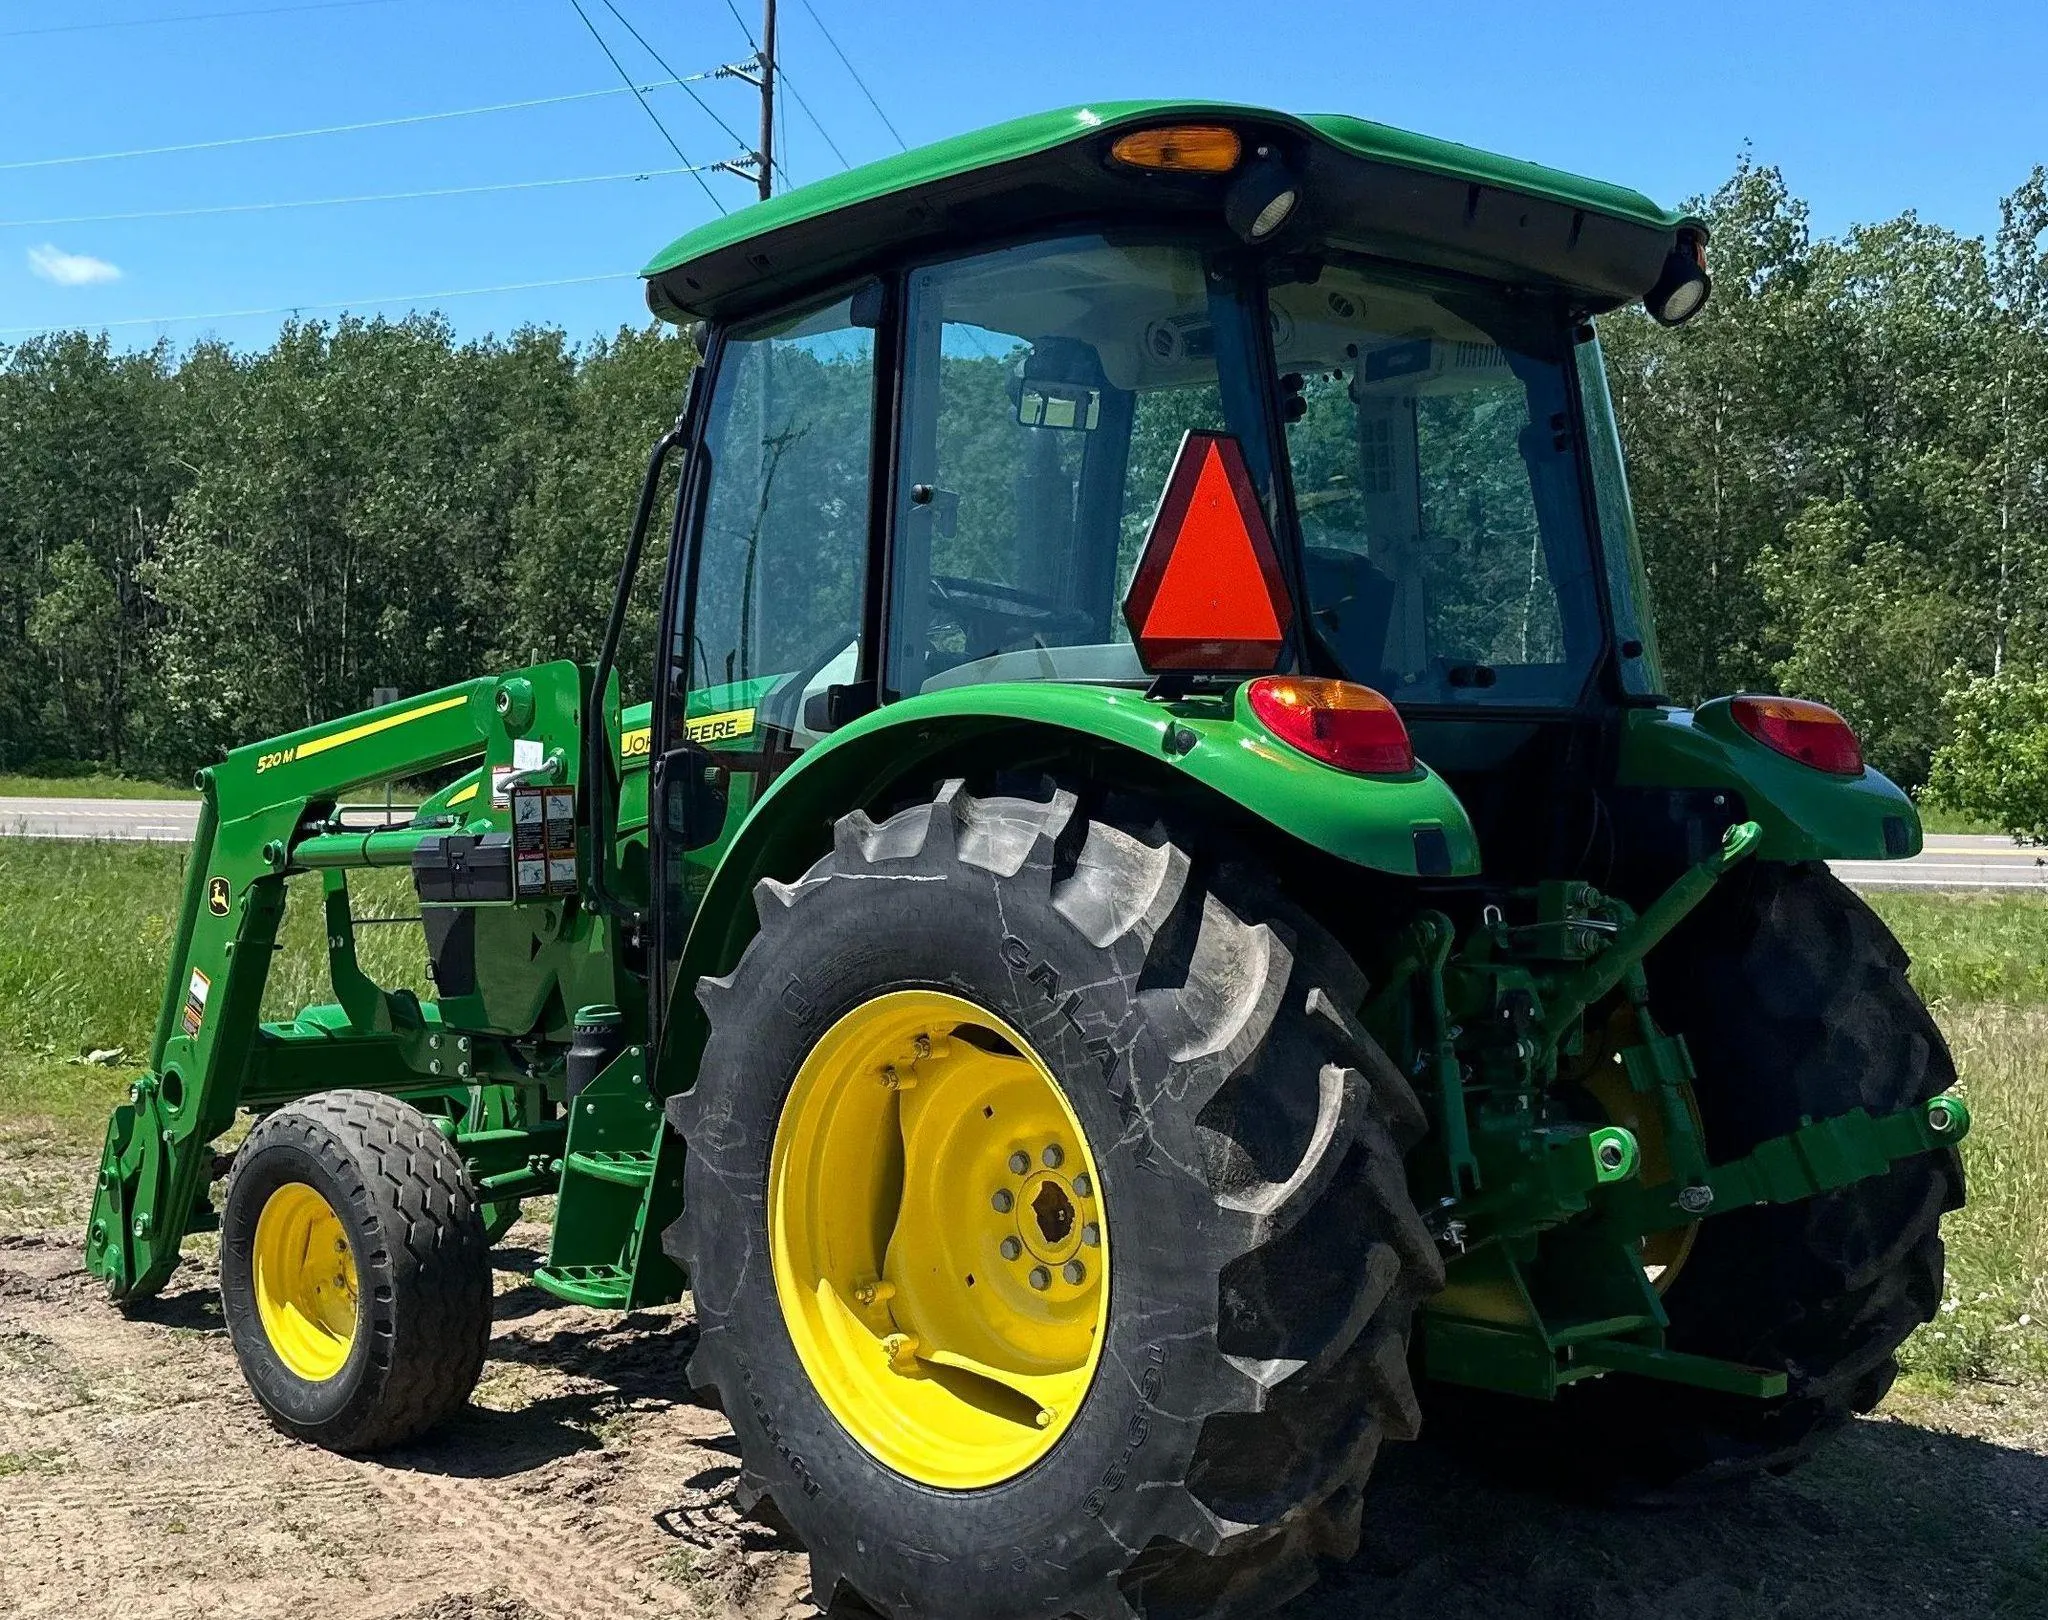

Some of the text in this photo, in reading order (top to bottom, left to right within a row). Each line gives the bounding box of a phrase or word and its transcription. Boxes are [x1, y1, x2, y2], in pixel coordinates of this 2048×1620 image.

[621, 719, 738, 754] JO EERE
[999, 934, 1173, 1178] GALAXY
